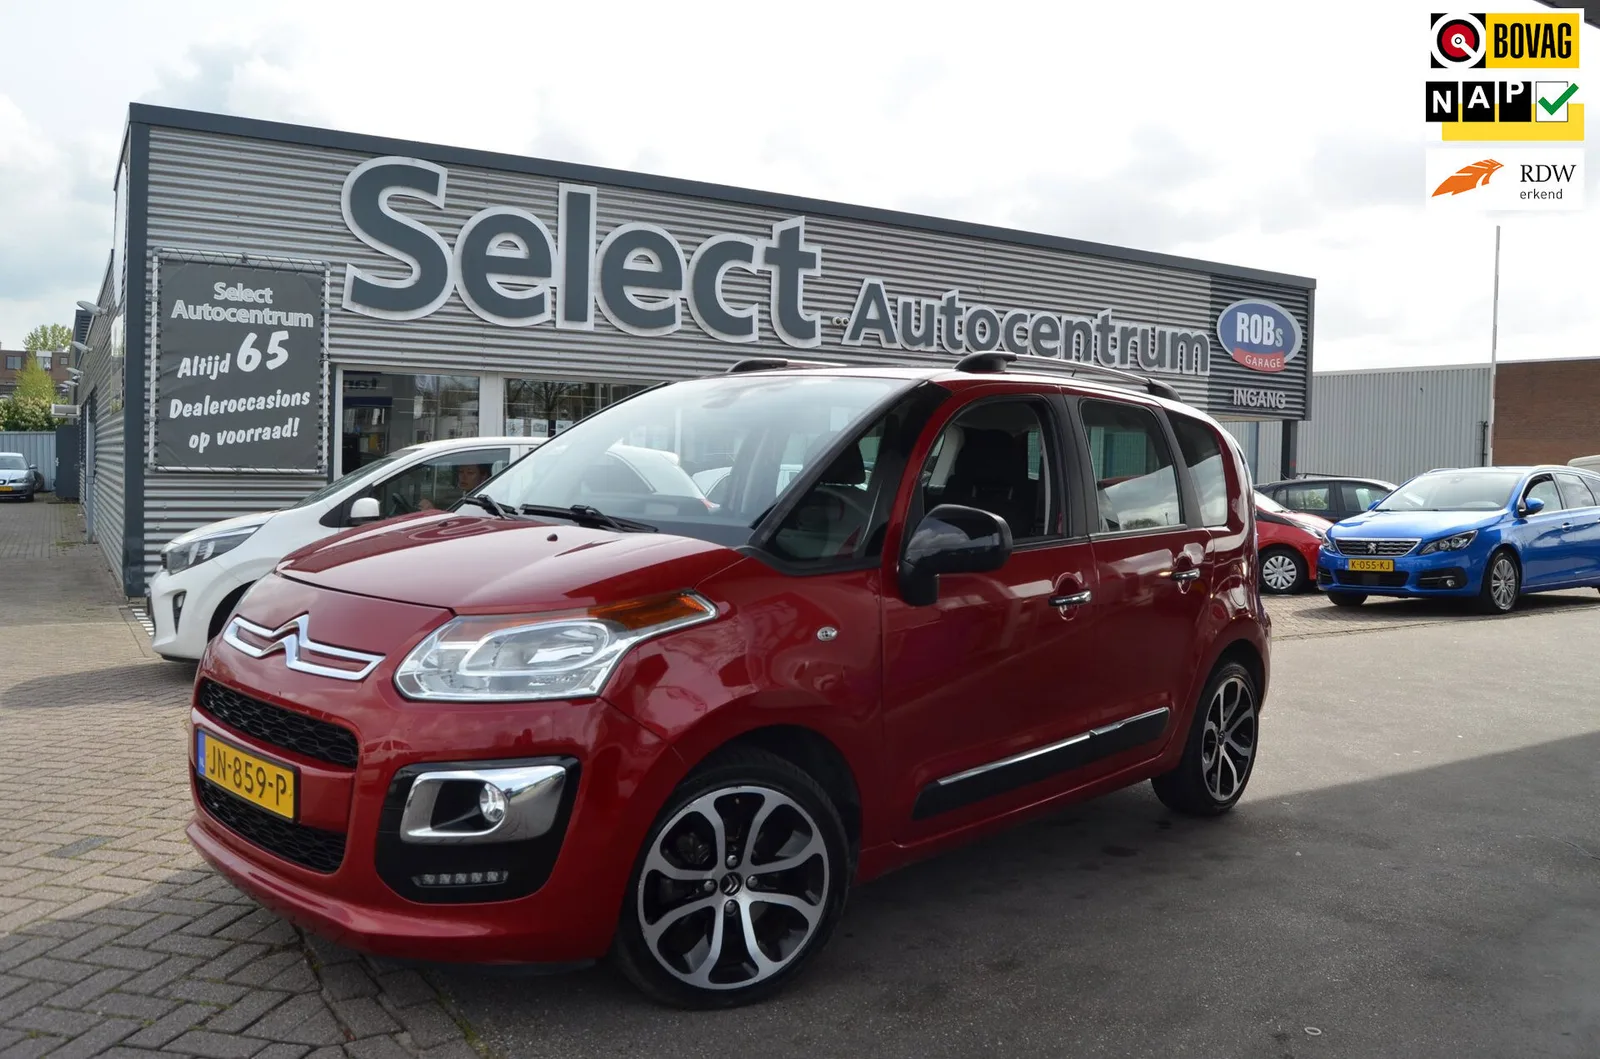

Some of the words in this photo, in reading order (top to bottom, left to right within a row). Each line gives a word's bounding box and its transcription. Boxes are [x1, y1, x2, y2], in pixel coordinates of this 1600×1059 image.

[340, 155, 822, 349] Select
[841, 277, 1210, 377] Autocentrum
[213, 281, 273, 304] Select
[171, 299, 314, 328] Autocentrum
[177, 352, 231, 380] Altijd
[236, 330, 290, 373] 65
[1245, 354, 1281, 369] GARAGE
[169, 389, 311, 419] Dealeroccasions
[1232, 387, 1286, 409] INGANG
[188, 432, 210, 453] op
[216, 417, 300, 445] voorraad!
[209, 745, 287, 806] JN-859-P
